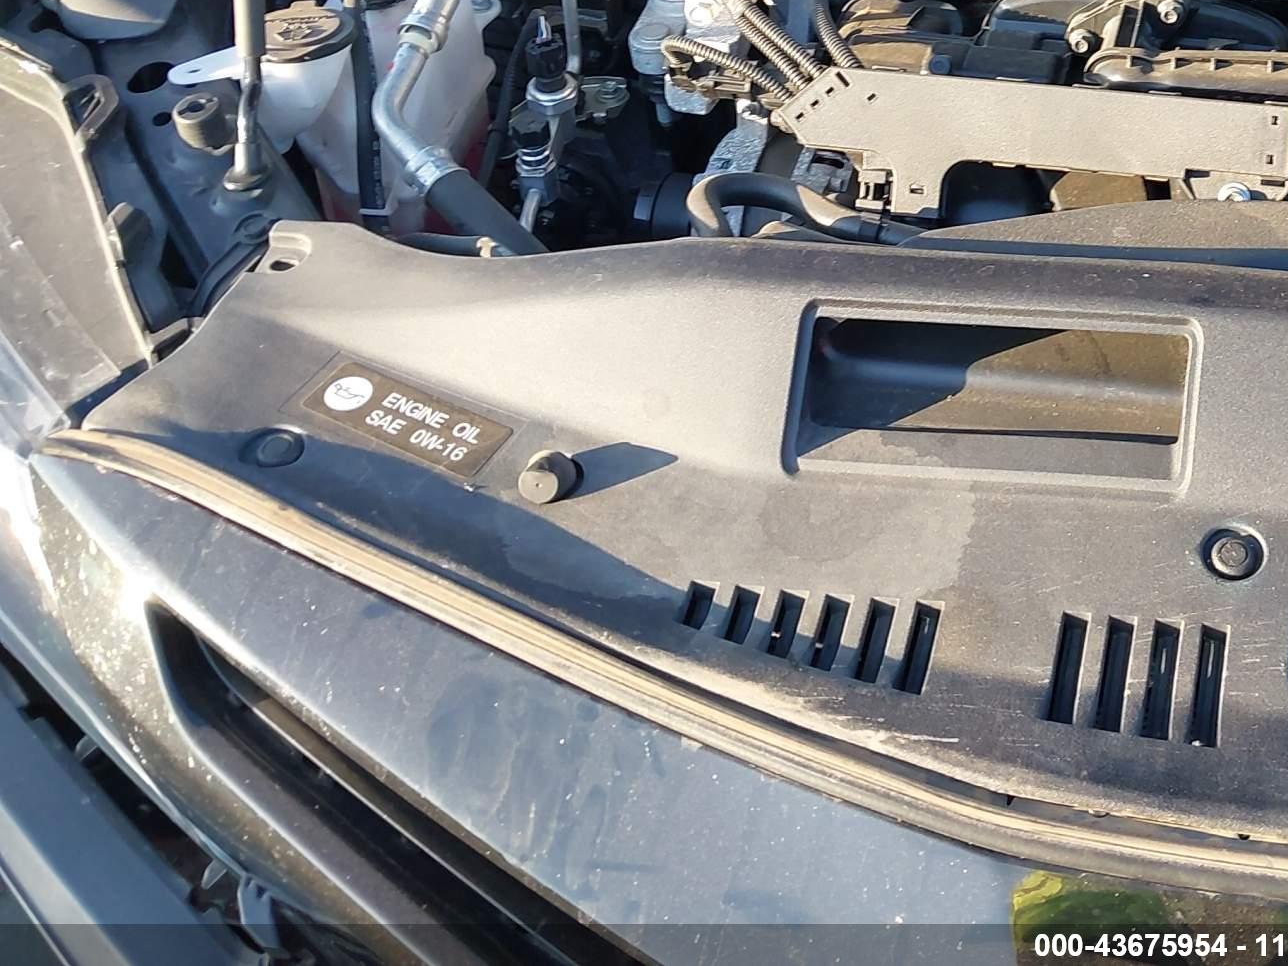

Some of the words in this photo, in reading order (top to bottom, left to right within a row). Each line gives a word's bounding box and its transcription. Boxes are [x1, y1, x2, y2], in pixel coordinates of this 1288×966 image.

[365, 409, 407, 435] SAE
[410, 429, 468, 462] 0W-16
[381, 392, 450, 429] ENGINE
[452, 422, 481, 444] OIL
